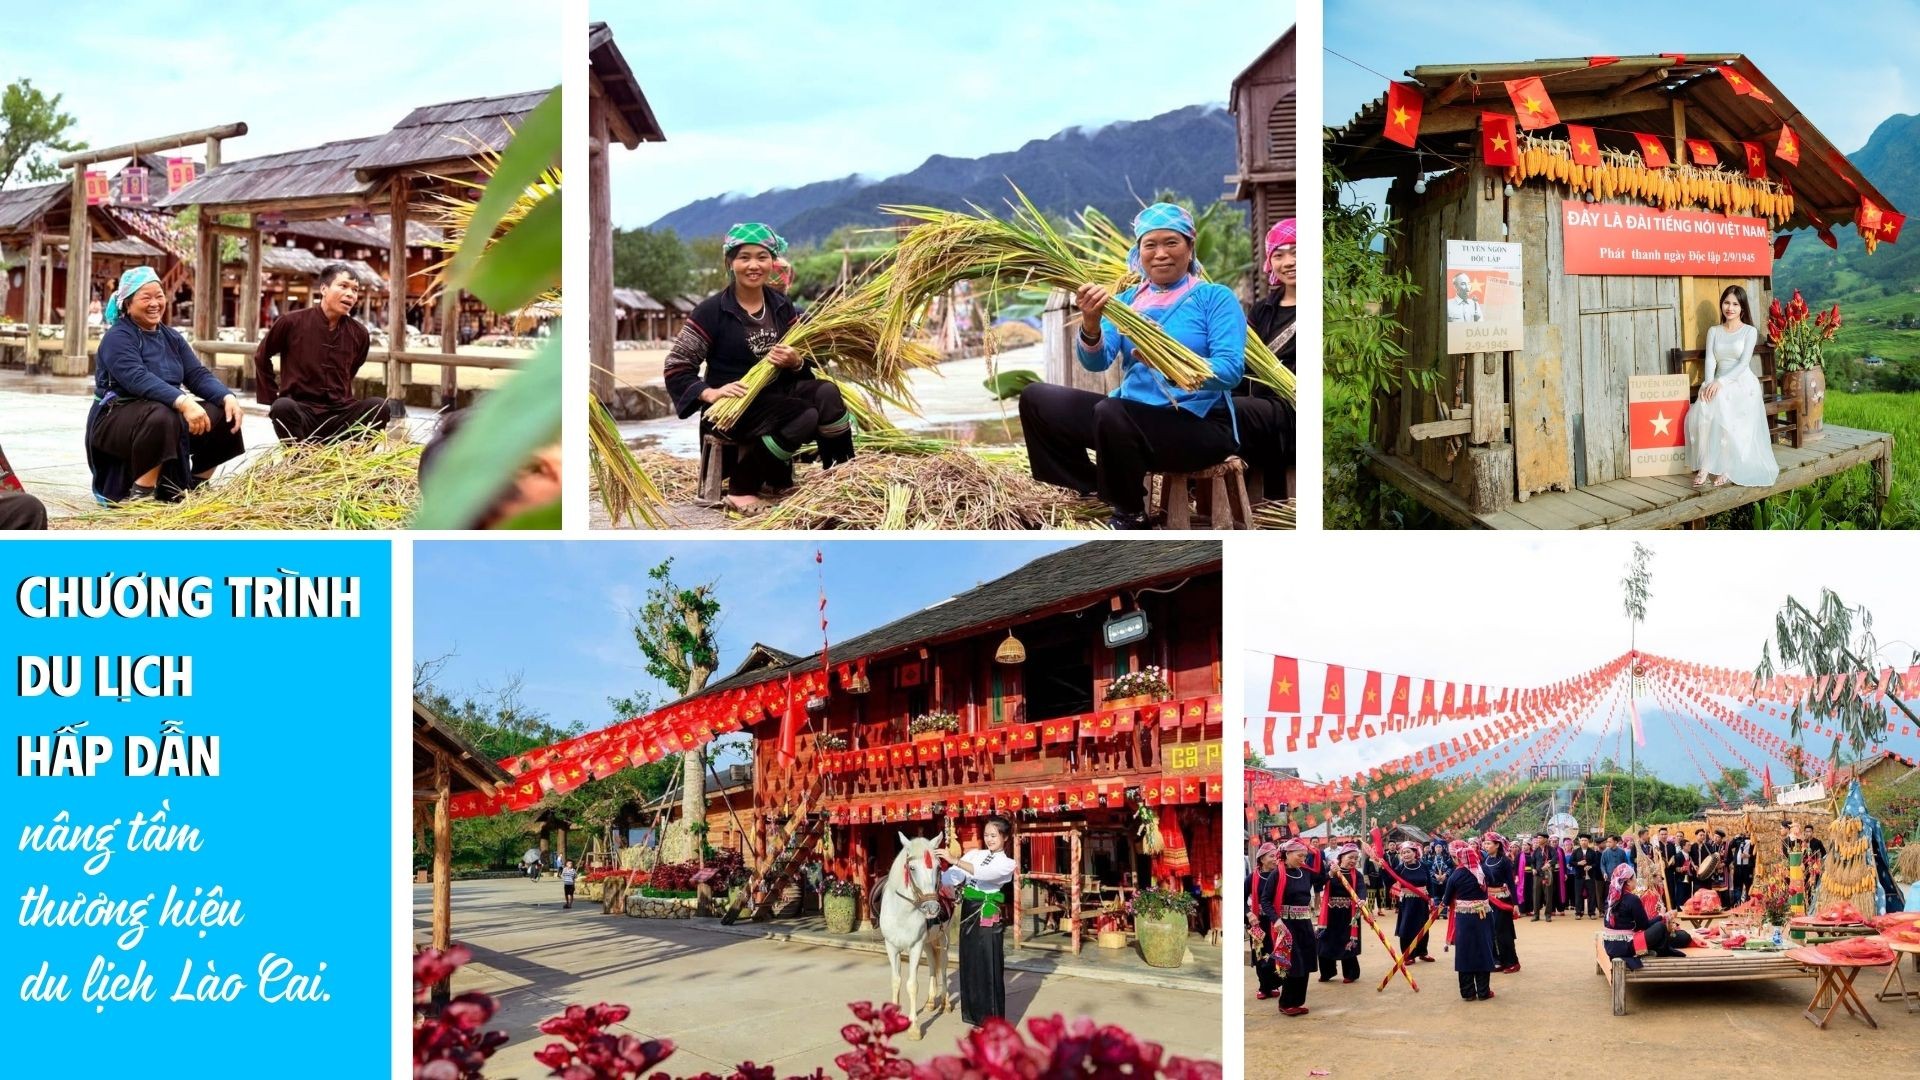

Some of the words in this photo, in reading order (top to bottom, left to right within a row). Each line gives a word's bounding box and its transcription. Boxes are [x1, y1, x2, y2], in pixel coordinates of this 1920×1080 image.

[1567, 208, 1600, 227] ĐÂY
[1603, 211, 1623, 229] LÀ
[1625, 214, 1651, 231] ĐÀI
[1653, 215, 1692, 233] TIẾNG
[1694, 219, 1715, 235] NÓI
[1717, 221, 1740, 239] VIỆT
[1742, 225, 1767, 238] NAM
[1600, 247, 1626, 259] Phát
[1631, 249, 1661, 260] thanh
[1663, 249, 1686, 263] ngày
[1688, 251, 1706, 263] Độc
[1707, 252, 1721, 265] lập
[1722, 252, 1756, 263] 2/9/1945
